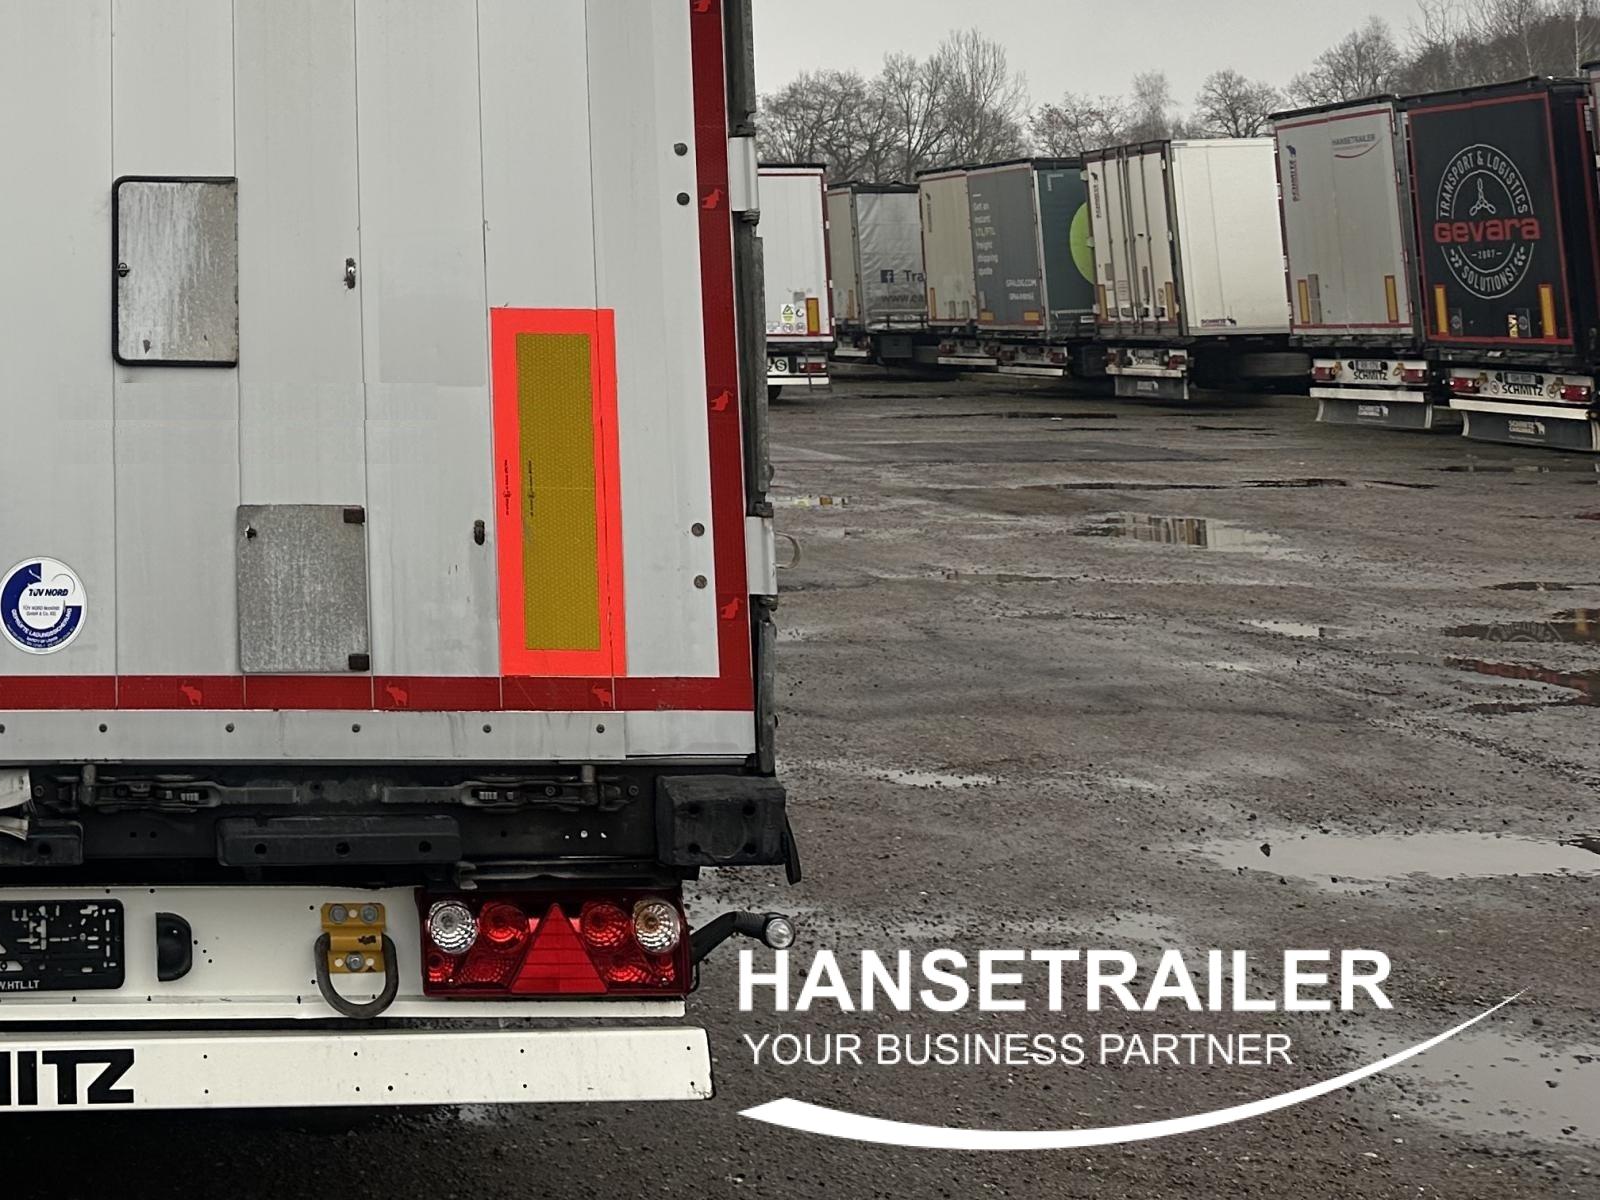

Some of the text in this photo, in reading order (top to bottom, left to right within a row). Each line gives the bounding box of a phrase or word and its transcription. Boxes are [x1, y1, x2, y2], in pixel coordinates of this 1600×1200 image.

[1440, 150, 1528, 217] TRANSPORT & LOGISTICS
[1461, 263, 1518, 293] SOLUTIONS!
[1502, 383, 1544, 397] SCHMITZ
[45, 588, 69, 597] NORD
